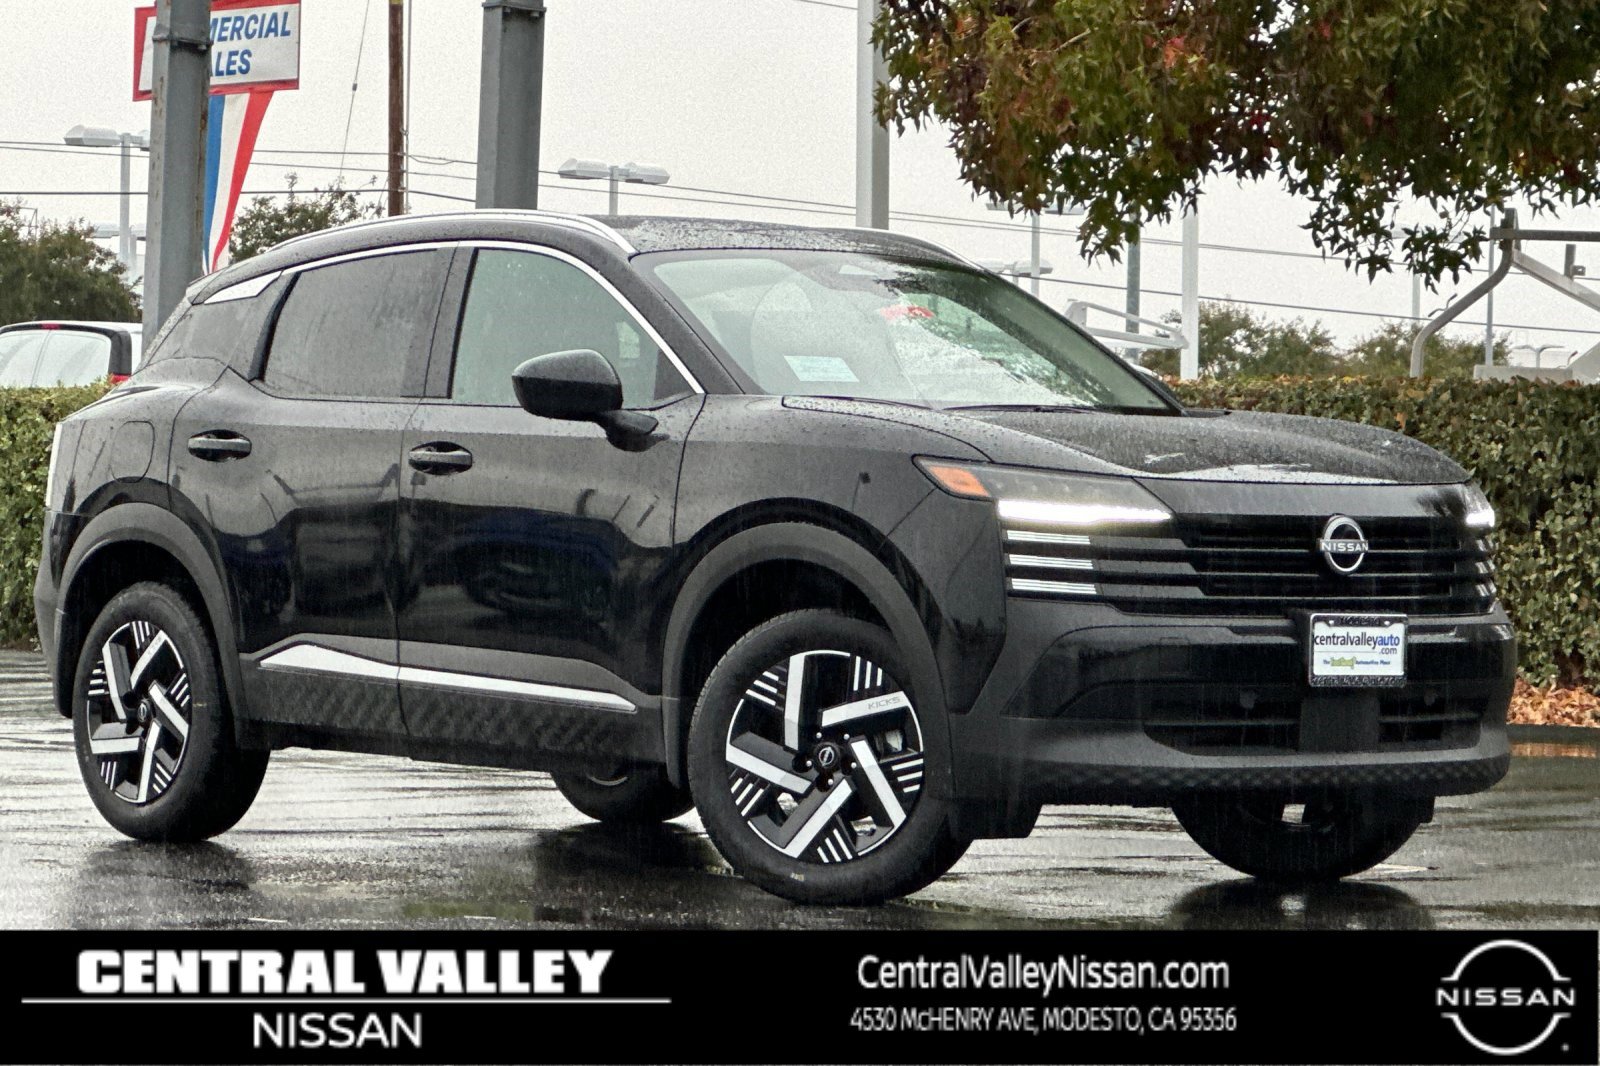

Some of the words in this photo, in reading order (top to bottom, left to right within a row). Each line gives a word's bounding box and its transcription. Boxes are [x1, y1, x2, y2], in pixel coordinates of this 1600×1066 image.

[210, 49, 252, 77] LES
[1321, 541, 1369, 552] NISSAN
[1313, 631, 1400, 650] centralvalleyauto
[867, 696, 901, 710] KICKS
